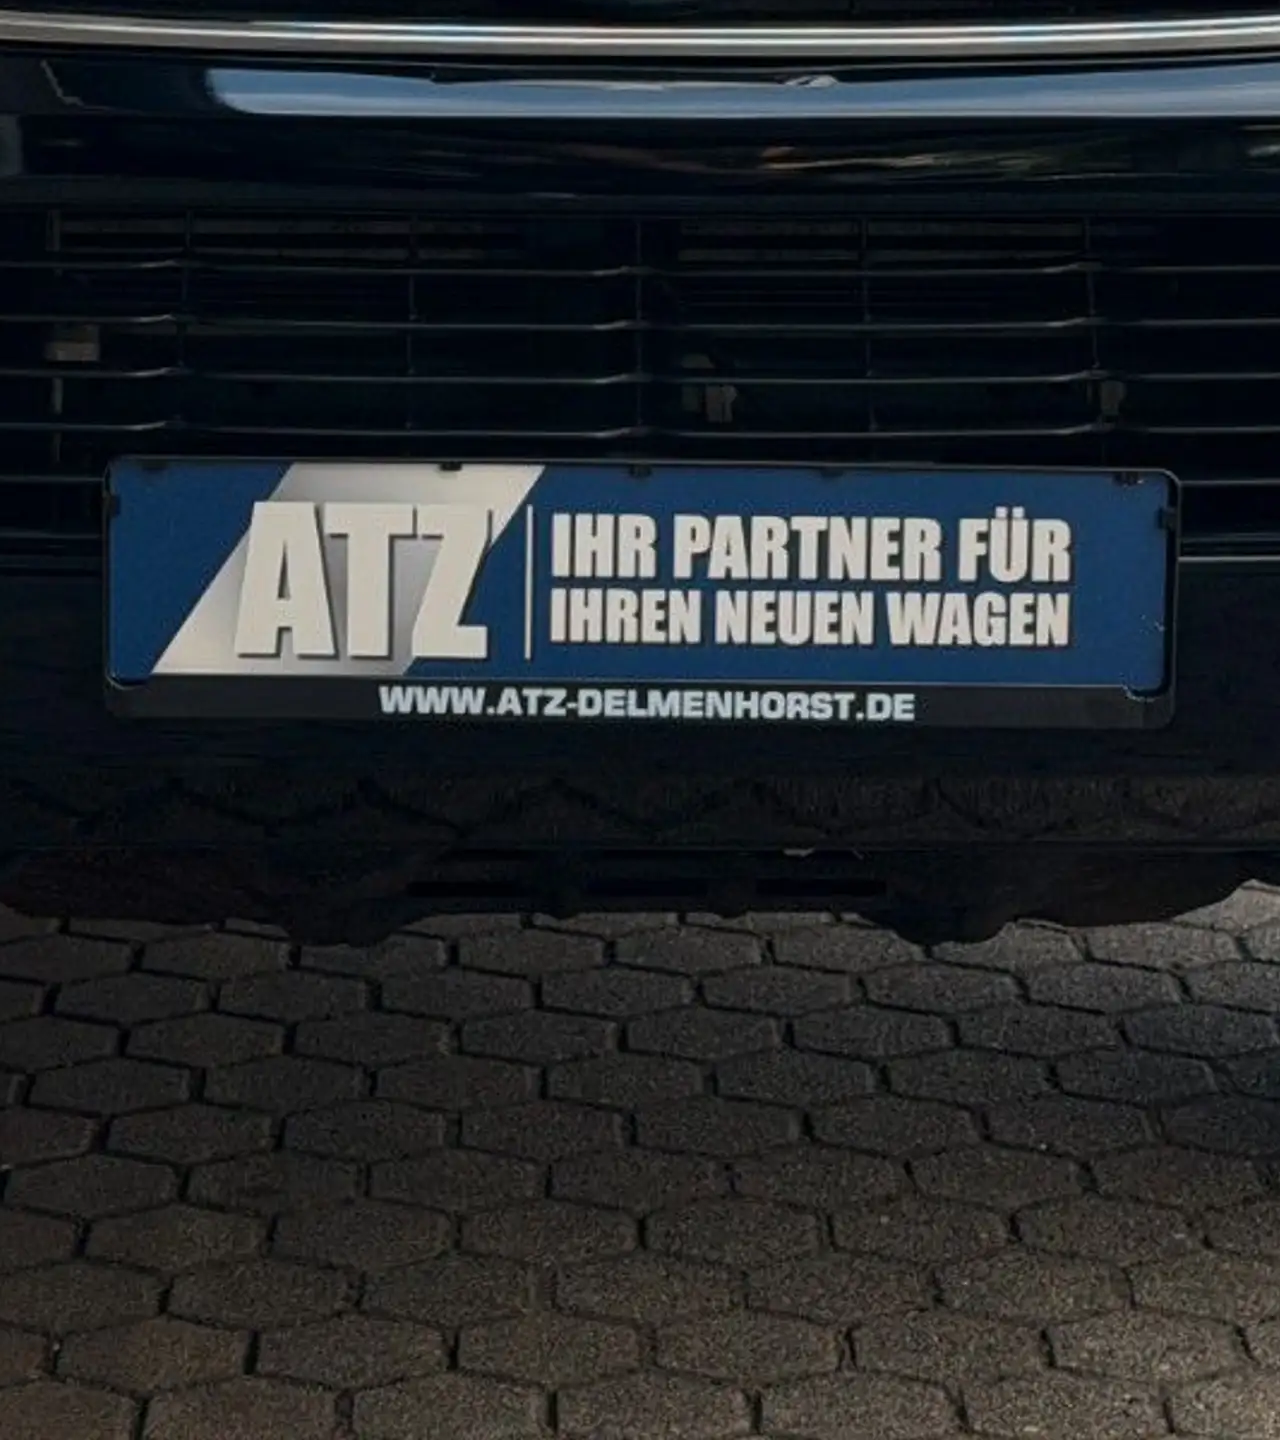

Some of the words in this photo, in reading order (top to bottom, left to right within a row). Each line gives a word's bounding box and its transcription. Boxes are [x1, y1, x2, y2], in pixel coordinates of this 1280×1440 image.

[551, 513, 657, 577] IHR
[673, 514, 943, 582] PARTNER
[957, 506, 1073, 583] FÜR
[234, 500, 491, 659] ATZ
[549, 587, 702, 644] IHREN
[714, 590, 874, 646] NEUEN
[886, 592, 1071, 647] WAGEN
[379, 684, 916, 723] WWW.ATZ-DELMENHORST.DE
